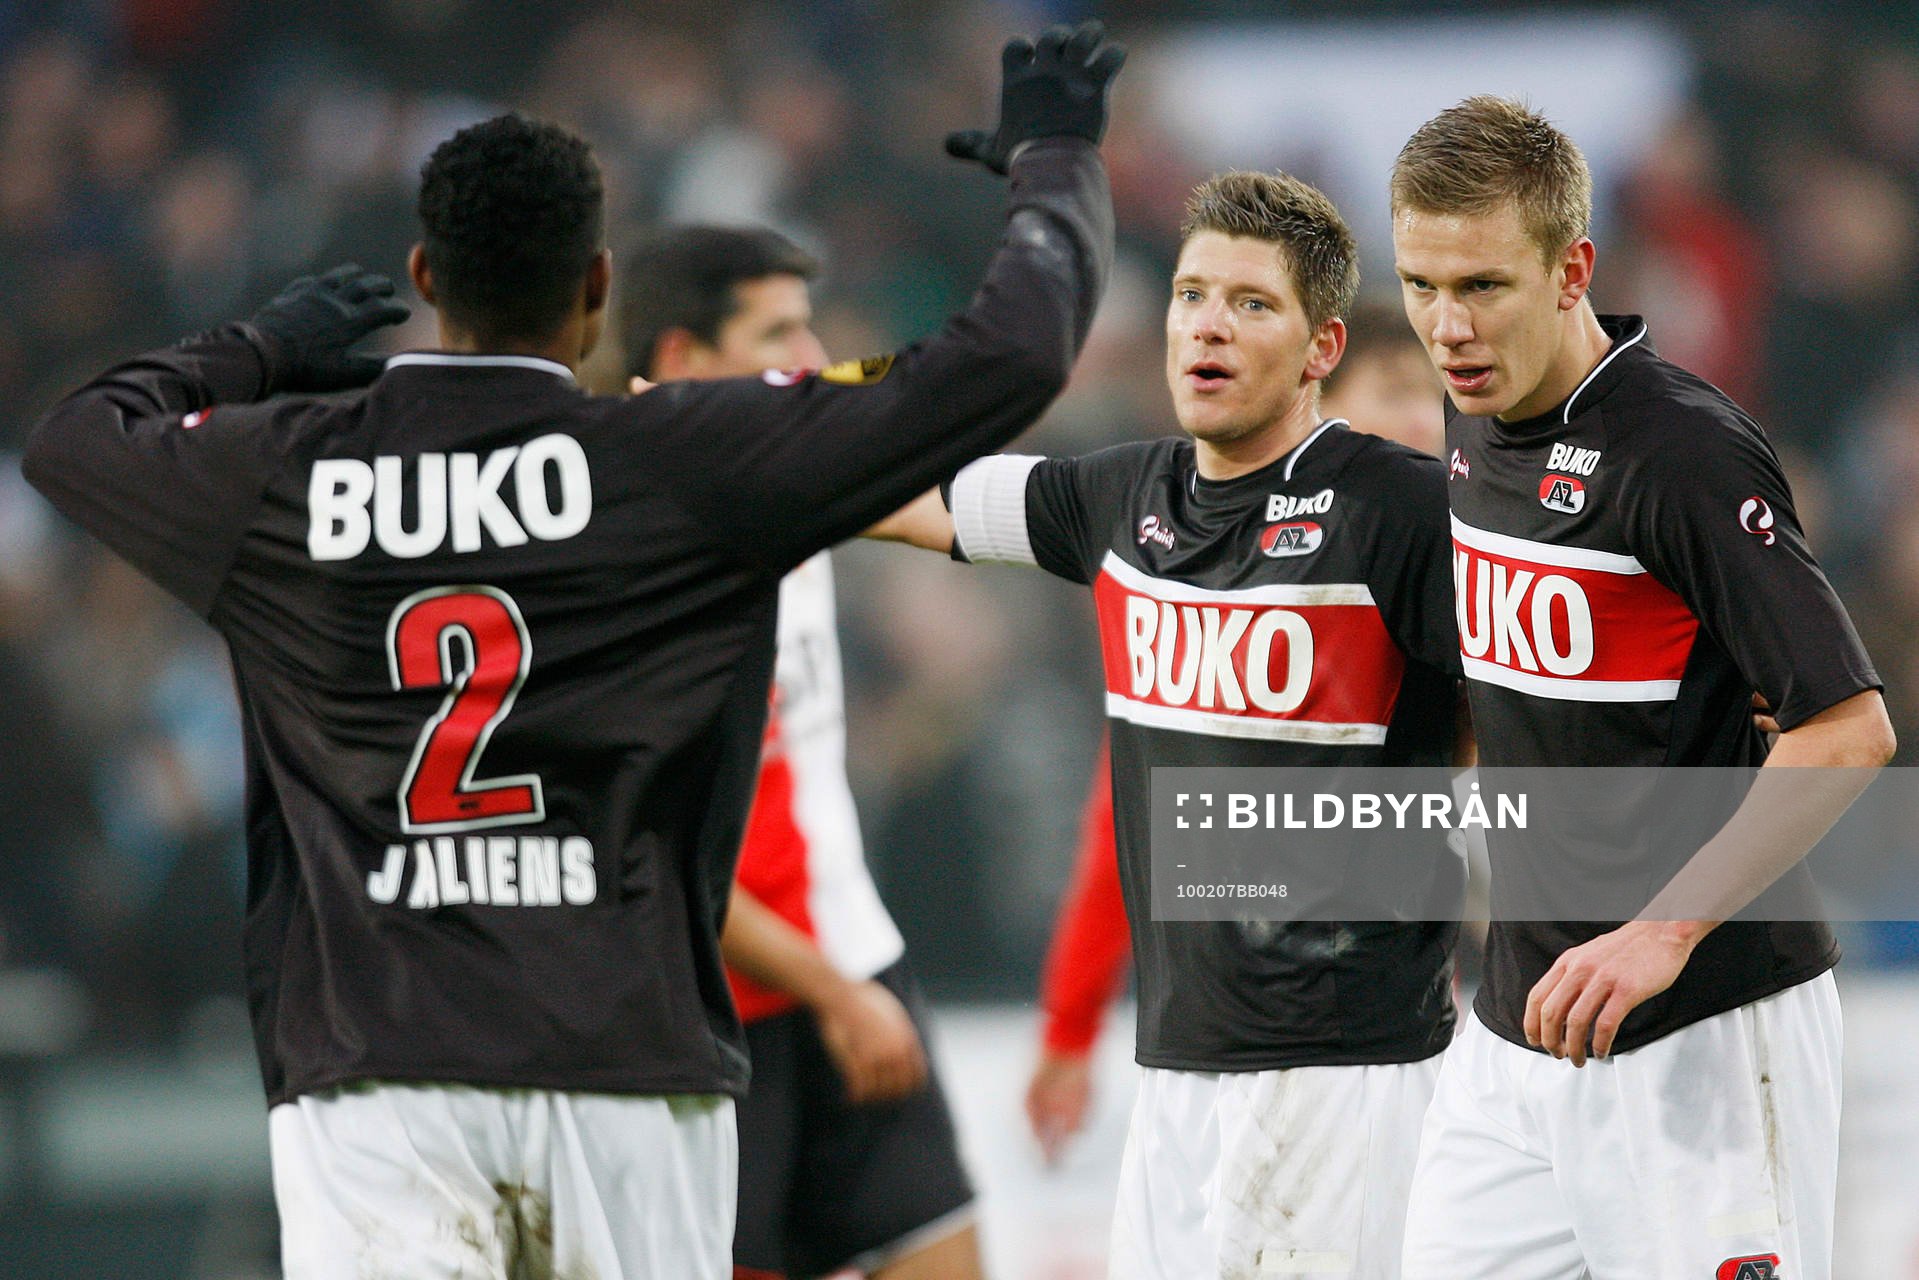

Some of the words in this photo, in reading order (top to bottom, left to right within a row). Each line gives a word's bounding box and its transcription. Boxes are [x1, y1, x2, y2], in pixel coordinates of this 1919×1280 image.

[1546, 442, 1602, 477] BUKO
[1547, 480, 1576, 509] AZ
[307, 433, 593, 561] BUKO
[1265, 488, 1335, 522] BUKO
[1271, 526, 1310, 554] AZ
[1452, 543, 1595, 676] UKO
[1127, 595, 1315, 713] BUKO
[385, 584, 546, 835] 2
[366, 835, 598, 909] JALIENS
